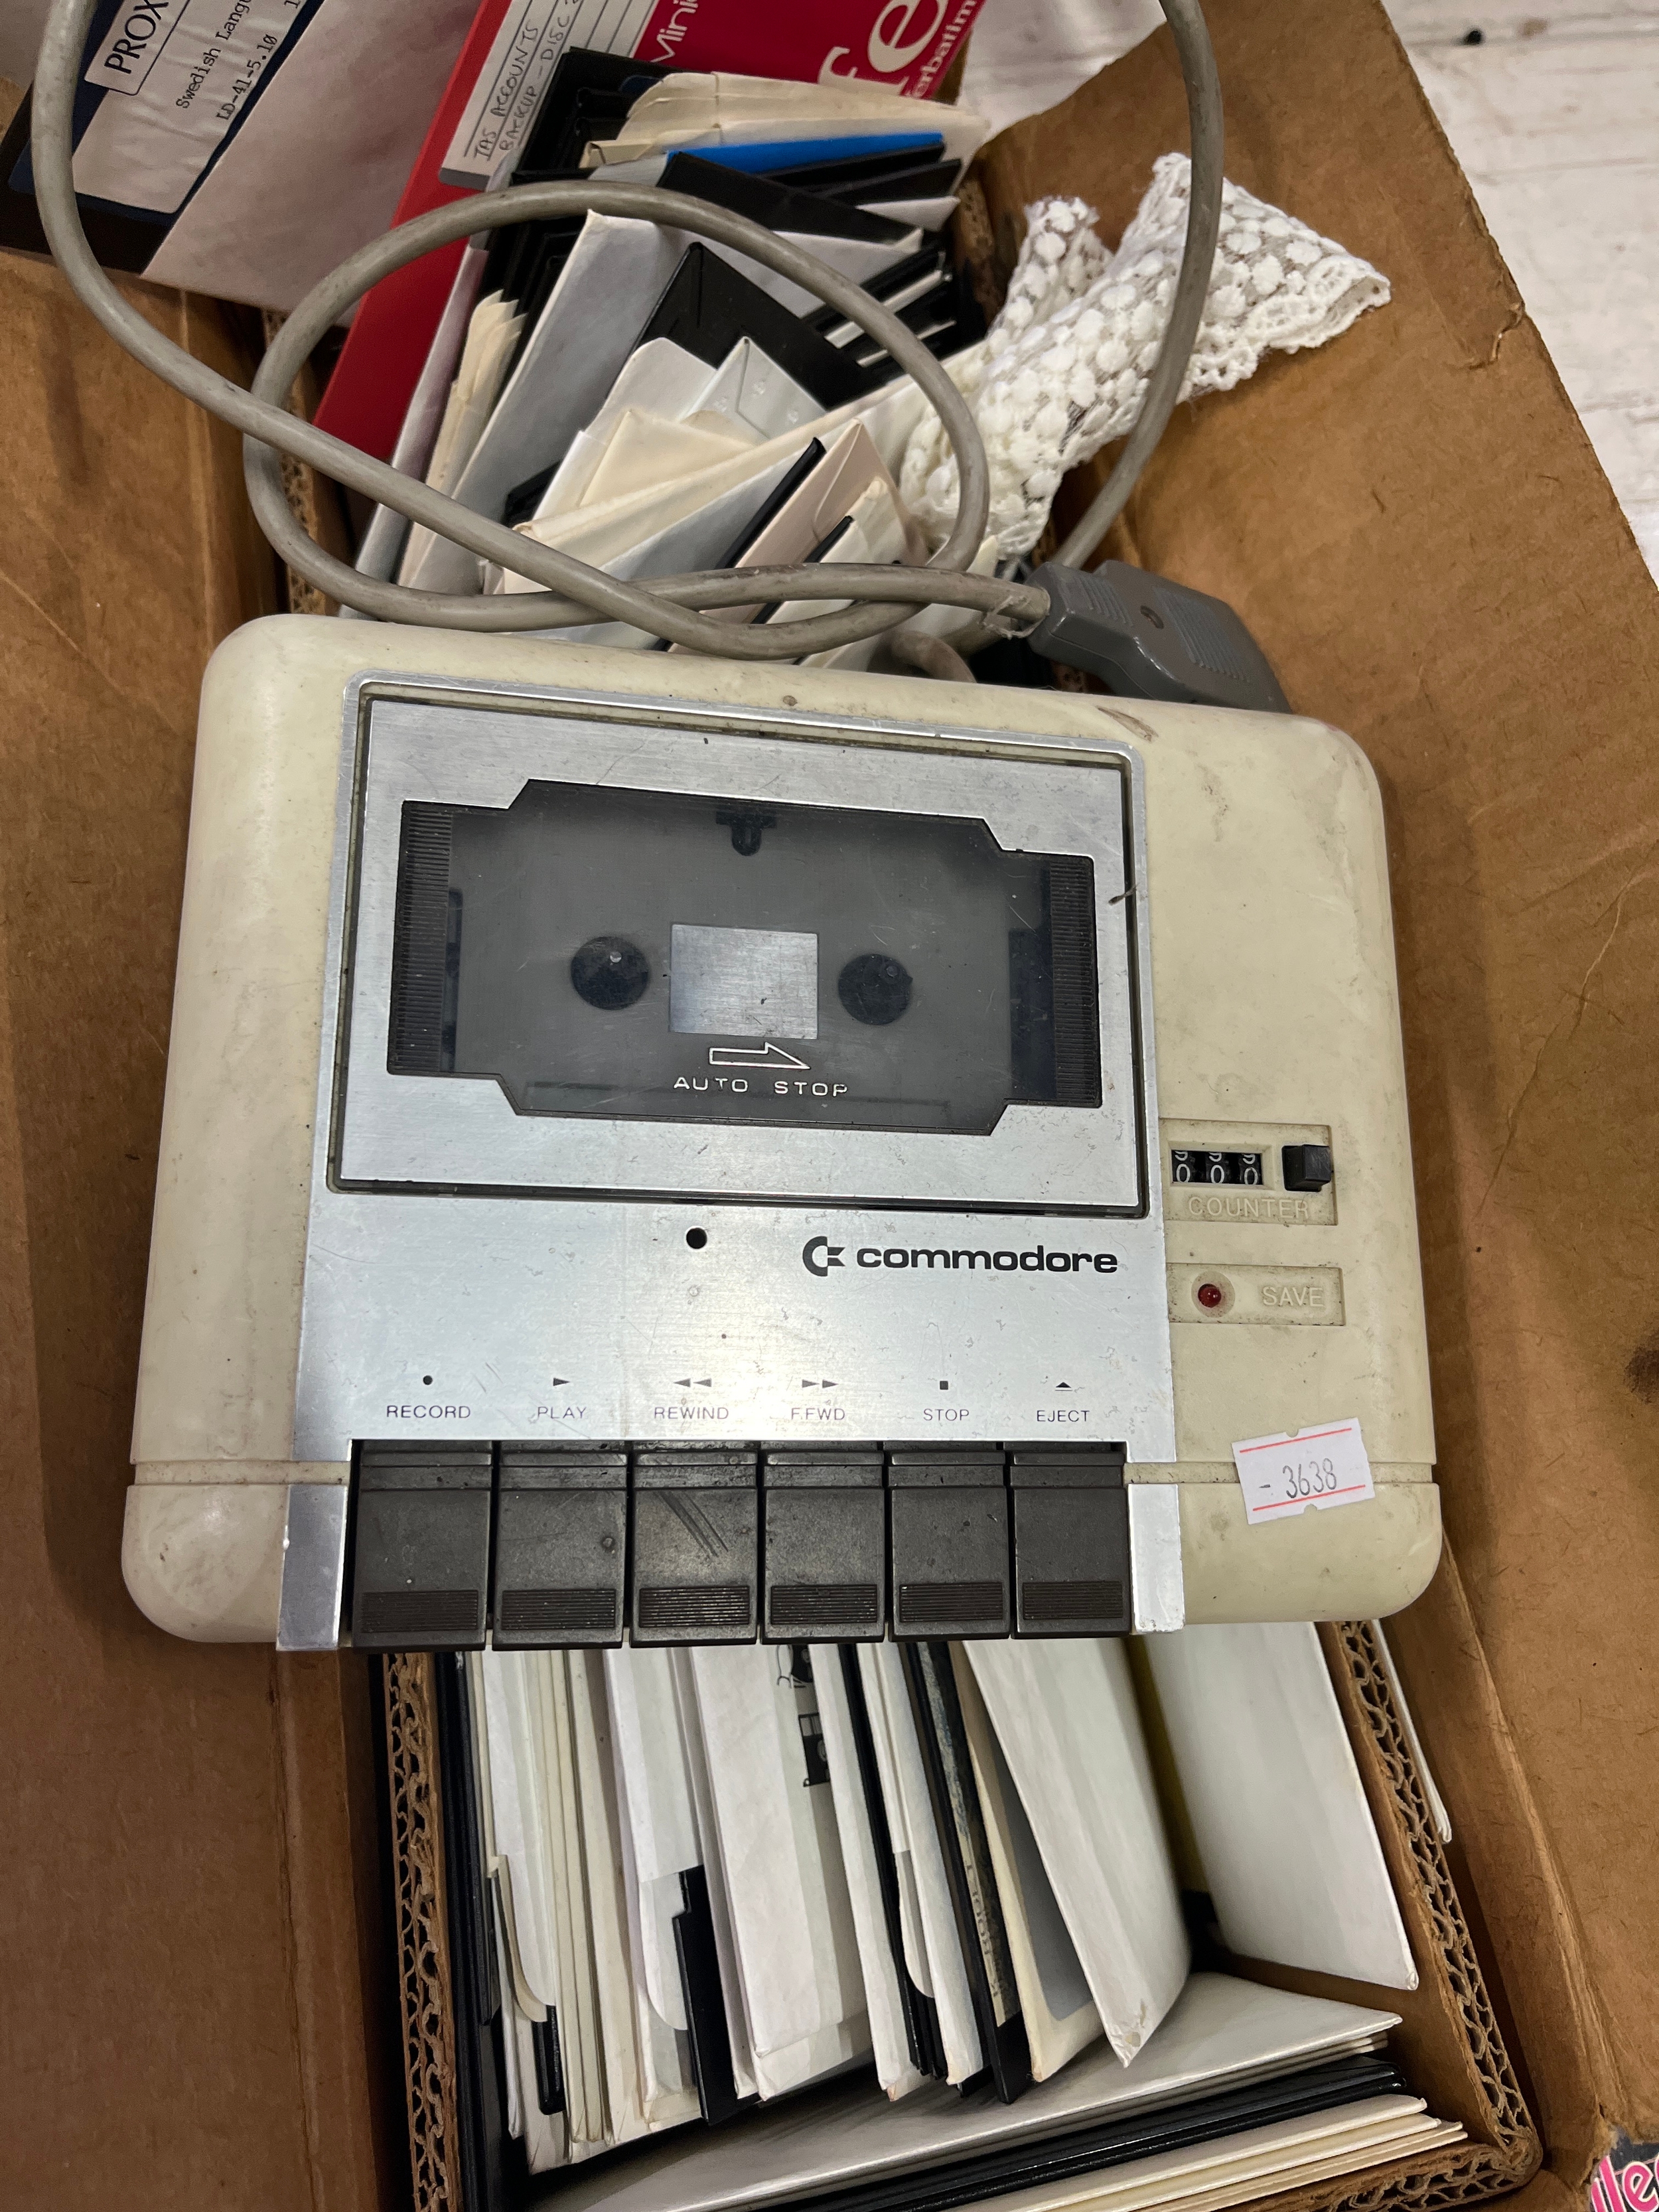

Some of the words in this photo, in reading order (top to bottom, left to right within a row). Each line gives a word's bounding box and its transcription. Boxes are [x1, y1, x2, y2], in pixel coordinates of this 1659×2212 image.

[650, 0, 699, 62] Mini
[906, 0, 981, 98] erbatim
[176, 48, 222, 109] Swedish
[499, 86, 537, 151] BACKUP
[541, 15, 570, 61] DISC
[674, 1076, 749, 1092] AUTO
[774, 1080, 848, 1097] STOP
[1189, 1196, 1309, 1219] COUNTER
[857, 1244, 1118, 1274] commodore
[1262, 1286, 1324, 1307] SAVE
[386, 1405, 471, 1419] RECORD
[538, 1406, 587, 1420] PLAY
[654, 1406, 729, 1420] REWIND
[923, 1408, 970, 1422] STOP
[1037, 1410, 1090, 1423] EJECT
[1282, 1457, 1337, 1499] 3638
